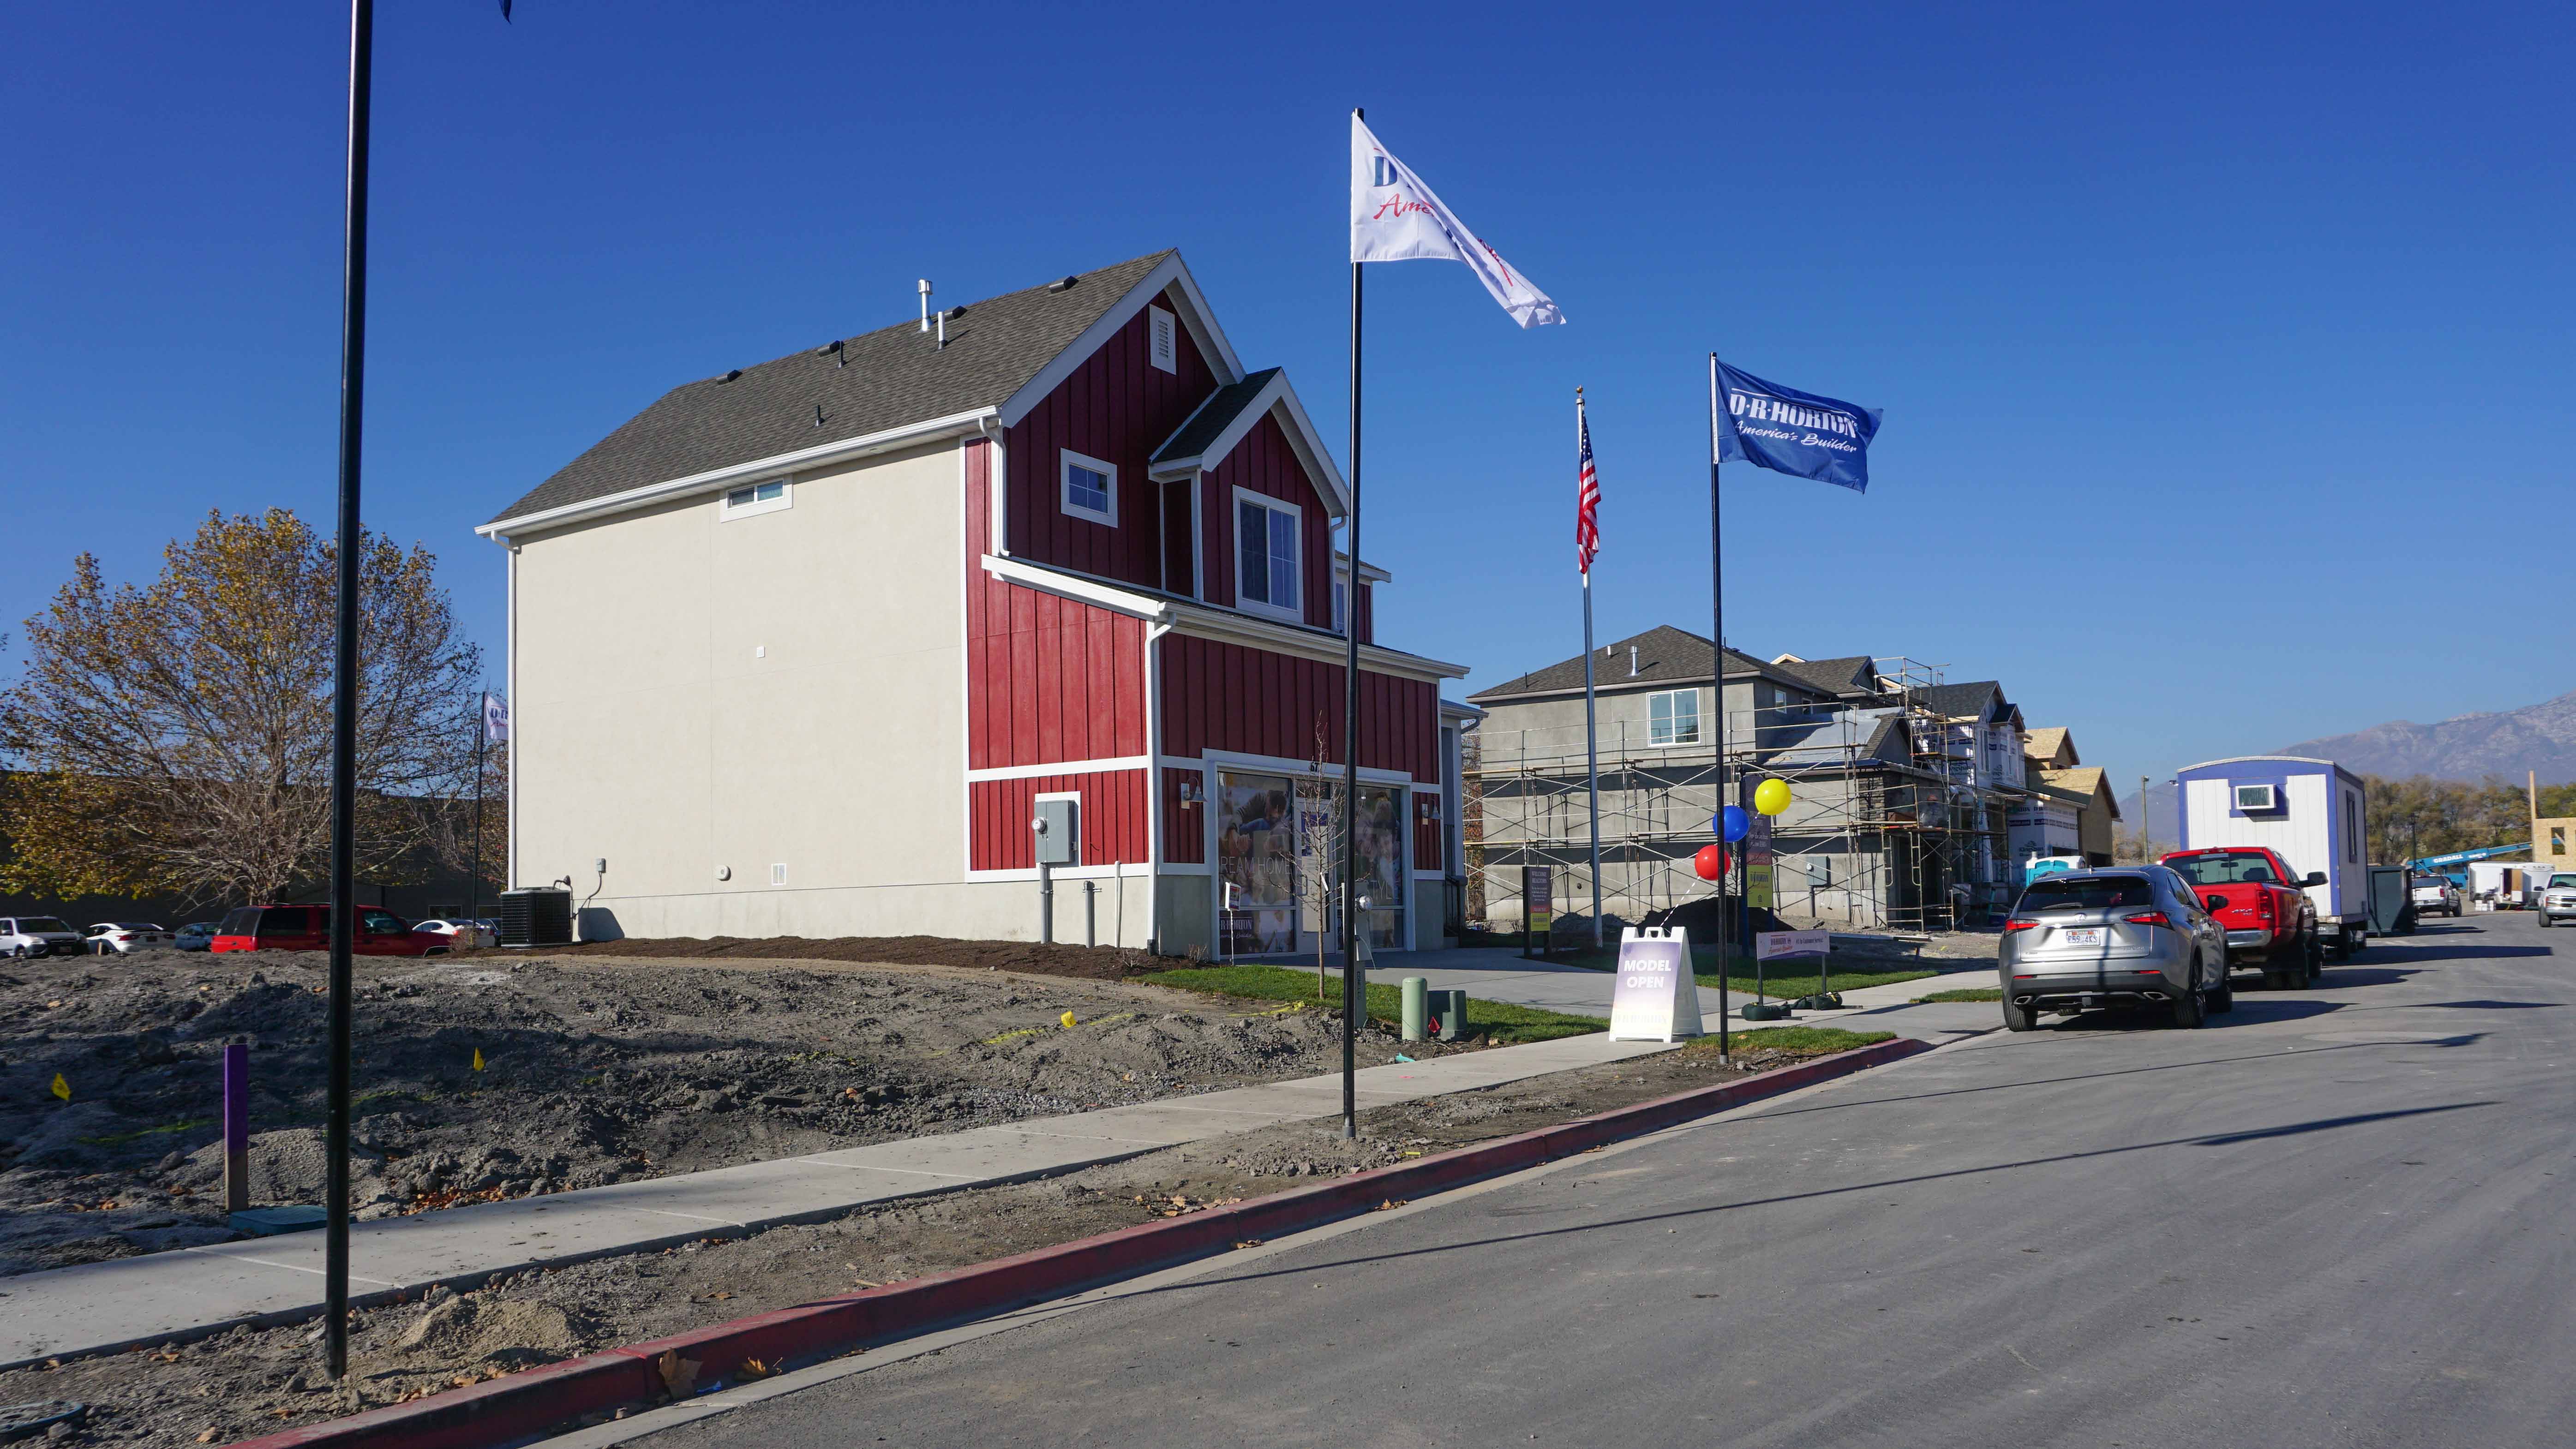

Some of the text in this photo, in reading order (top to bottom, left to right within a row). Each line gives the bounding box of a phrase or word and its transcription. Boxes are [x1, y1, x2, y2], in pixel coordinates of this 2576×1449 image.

[1735, 420, 1857, 452] America's Builder
[2433, 854, 2463, 863] GRADALL
[1258, 857, 1291, 874] HOME
[1624, 960, 1671, 971] MODEL
[1627, 976, 1665, 988] OPEN
